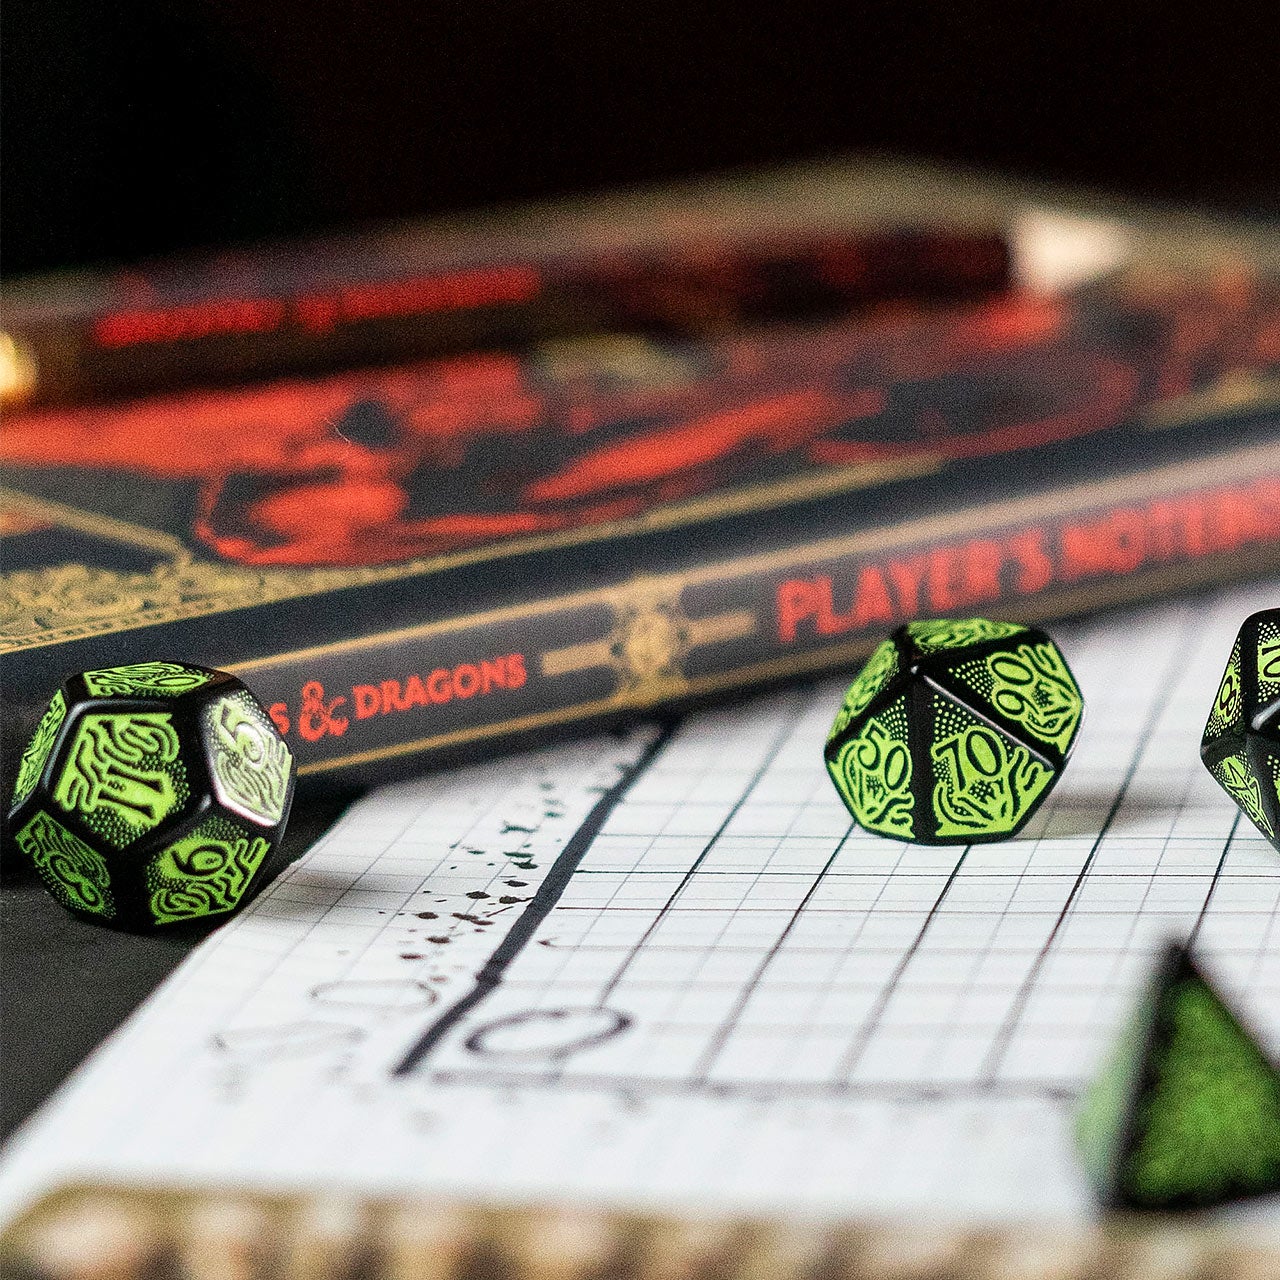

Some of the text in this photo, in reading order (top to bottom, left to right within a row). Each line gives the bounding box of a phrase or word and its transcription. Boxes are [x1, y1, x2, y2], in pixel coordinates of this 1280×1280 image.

[776, 527, 1053, 644] PLAYER'S
[299, 681, 349, 742] &
[353, 653, 528, 720] DRAGONS
[991, 656, 1039, 717] 90
[857, 725, 905, 790] 50
[935, 730, 1002, 792] 70
